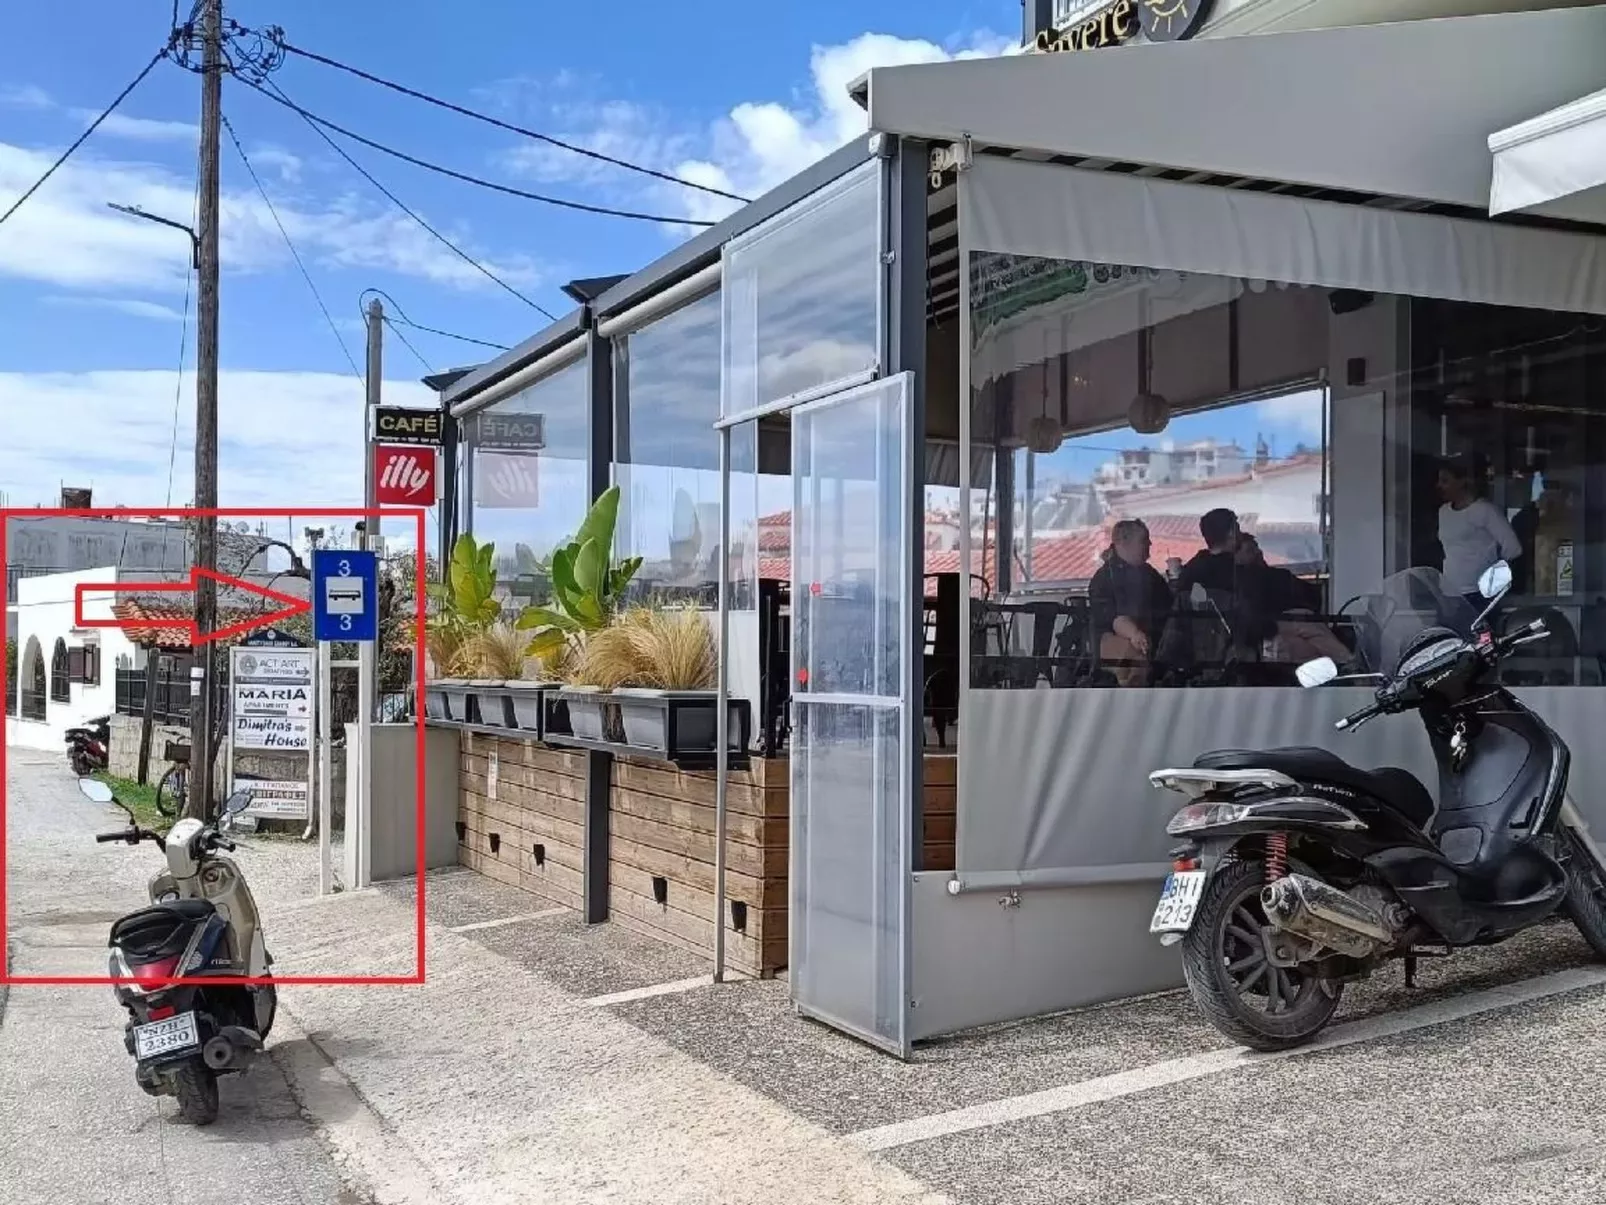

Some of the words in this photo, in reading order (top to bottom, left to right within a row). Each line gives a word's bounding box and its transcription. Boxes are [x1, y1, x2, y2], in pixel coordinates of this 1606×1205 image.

[379, 414, 437, 433] CAFÉ
[379, 454, 430, 497] illy
[338, 559, 351, 577] 3
[340, 613, 352, 631] 3
[238, 688, 307, 700] MARIA
[237, 718, 292, 732] Dimitra's
[264, 733, 307, 748] House
[1161, 903, 1192, 924] 213
[145, 1030, 189, 1052] 2380
